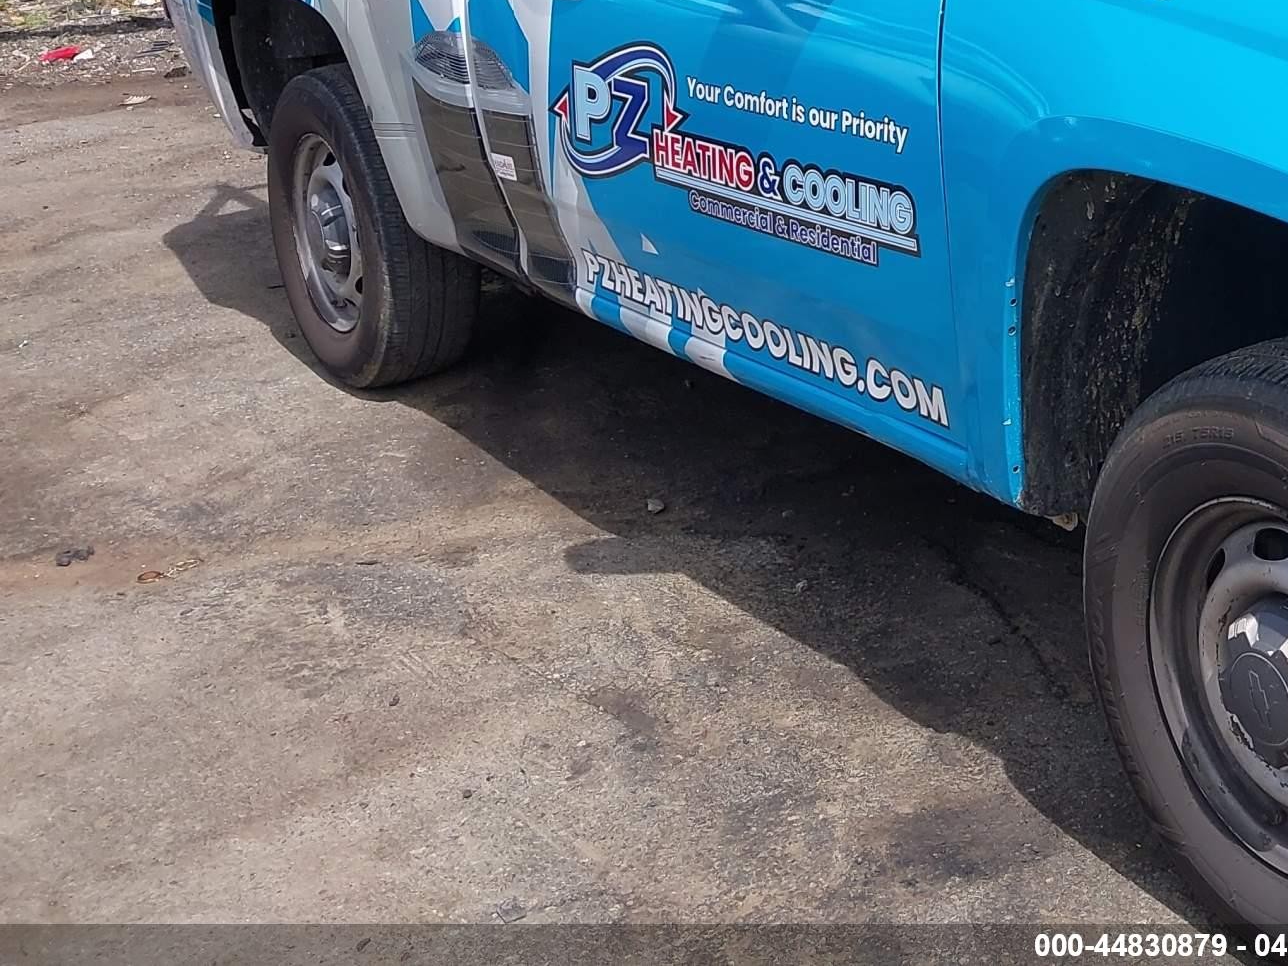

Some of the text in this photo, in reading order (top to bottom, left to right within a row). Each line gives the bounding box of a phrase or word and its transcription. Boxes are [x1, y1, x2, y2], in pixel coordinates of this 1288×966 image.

[687, 77, 908, 154] Your Comfort is our Priority
[653, 128, 914, 234] HEATING & COOLING
[688, 190, 878, 265] Commercial & Residential
[585, 251, 950, 427] PZHEATINGCOOLING.COM
